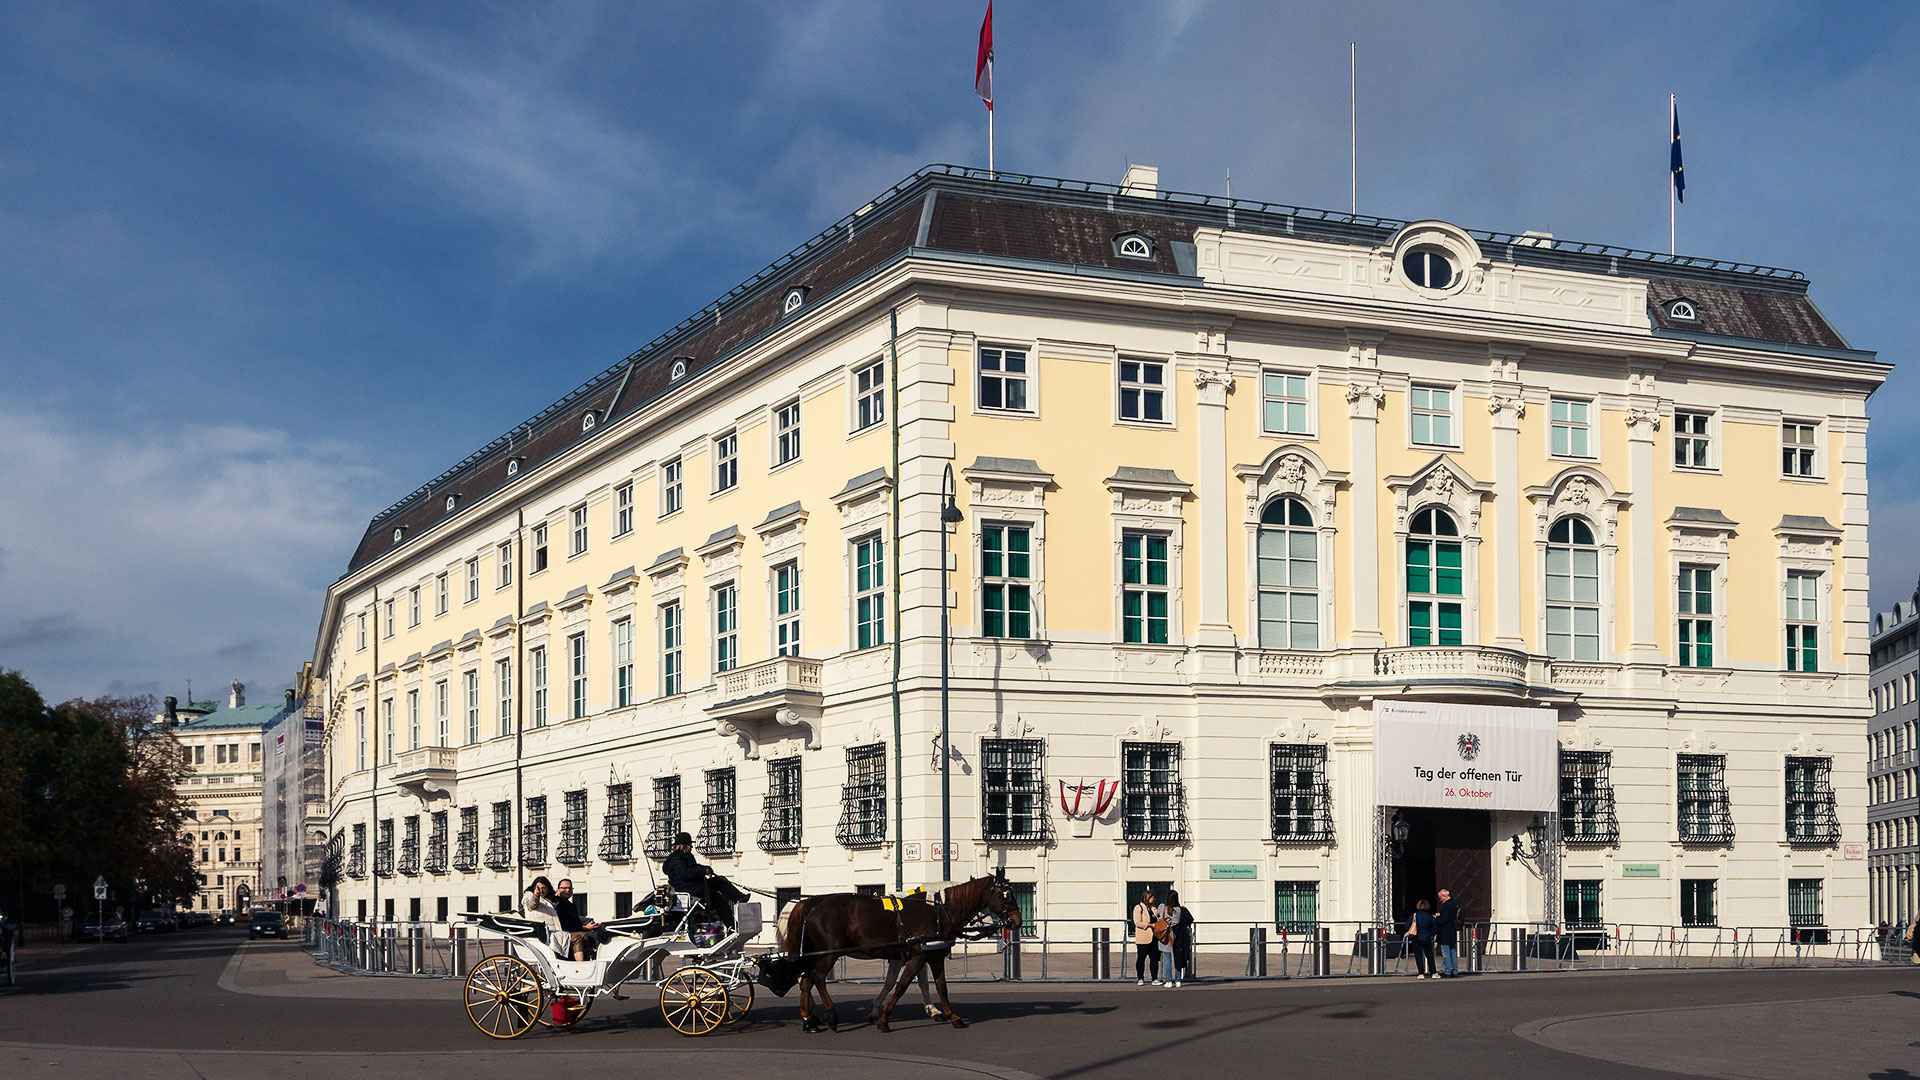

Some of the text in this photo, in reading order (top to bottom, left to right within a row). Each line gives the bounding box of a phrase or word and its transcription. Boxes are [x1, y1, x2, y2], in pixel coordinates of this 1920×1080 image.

[1414, 766, 1522, 782] Tag der offenen Tür
[1444, 787, 1493, 798] 26. Oktober
